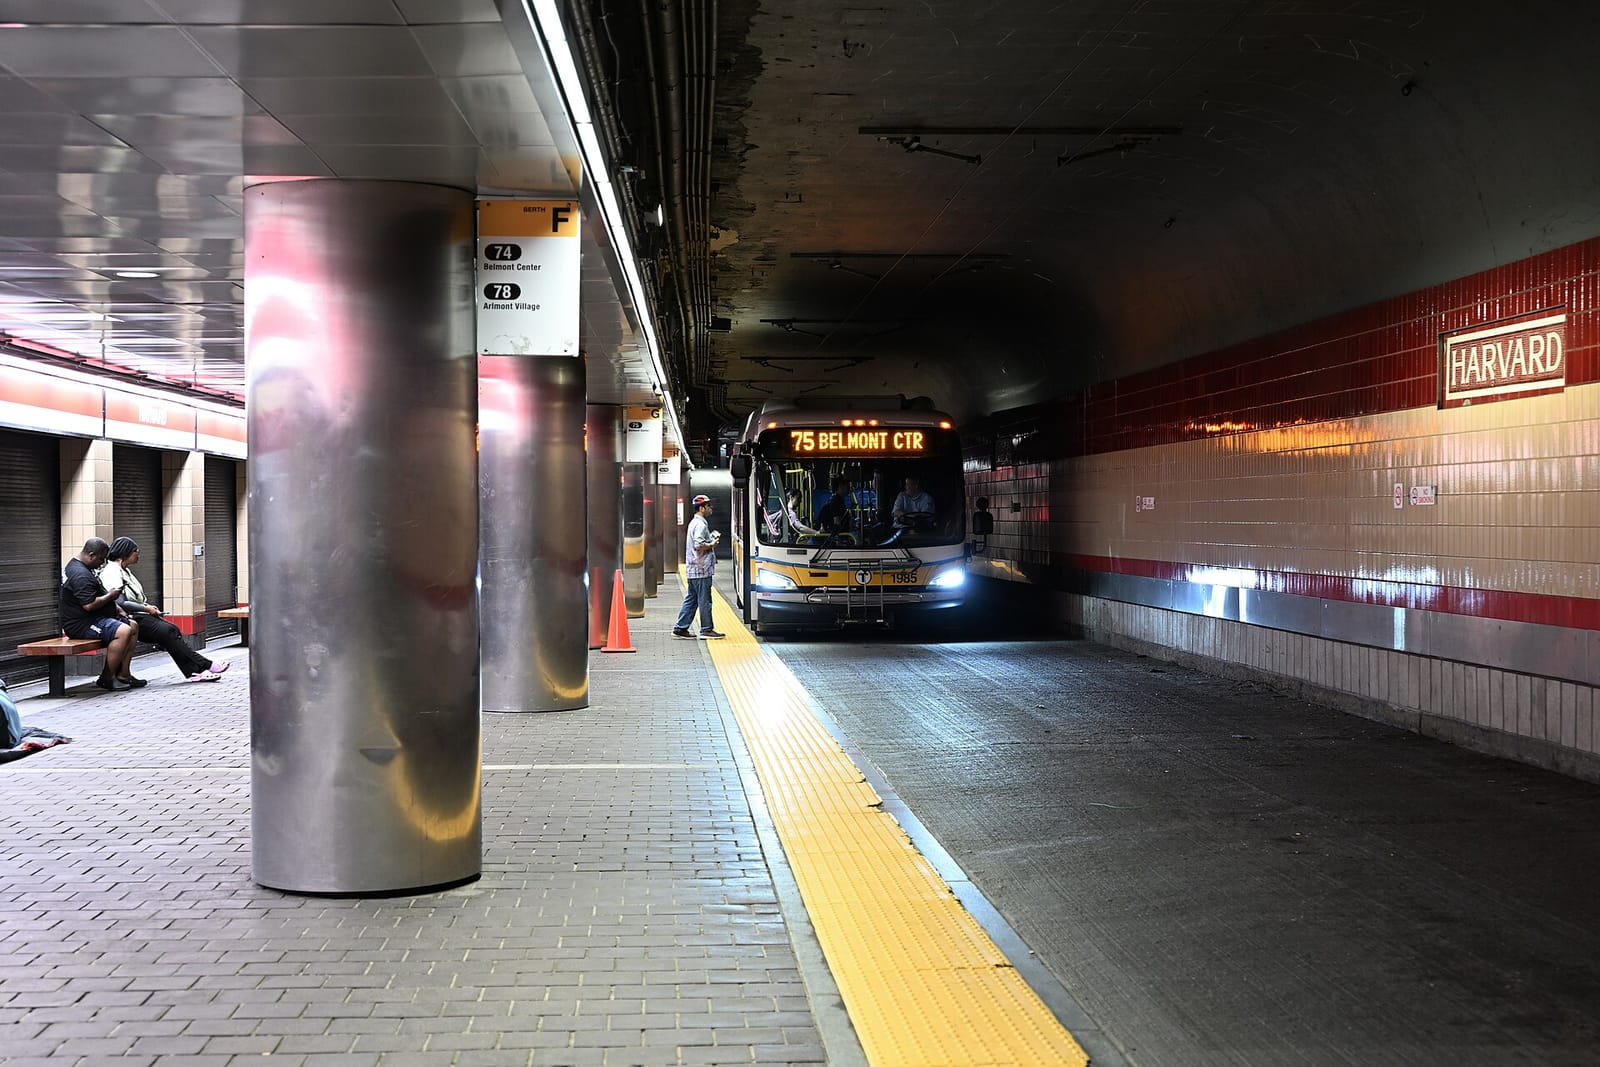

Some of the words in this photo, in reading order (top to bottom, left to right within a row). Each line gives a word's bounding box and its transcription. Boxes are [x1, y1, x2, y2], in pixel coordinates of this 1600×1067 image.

[552, 207, 571, 232] F
[494, 246, 512, 259] 74
[483, 263, 515, 271] Belmont
[516, 263, 541, 271] Center
[493, 285, 512, 298] 78
[514, 303, 541, 311] Village
[1451, 332, 1562, 386] HARVARD
[651, 409, 660, 418] G
[791, 431, 815, 451] 75
[818, 432, 888, 449] BELMONT
[893, 432, 923, 449] CTR
[891, 574, 917, 583] 1985
